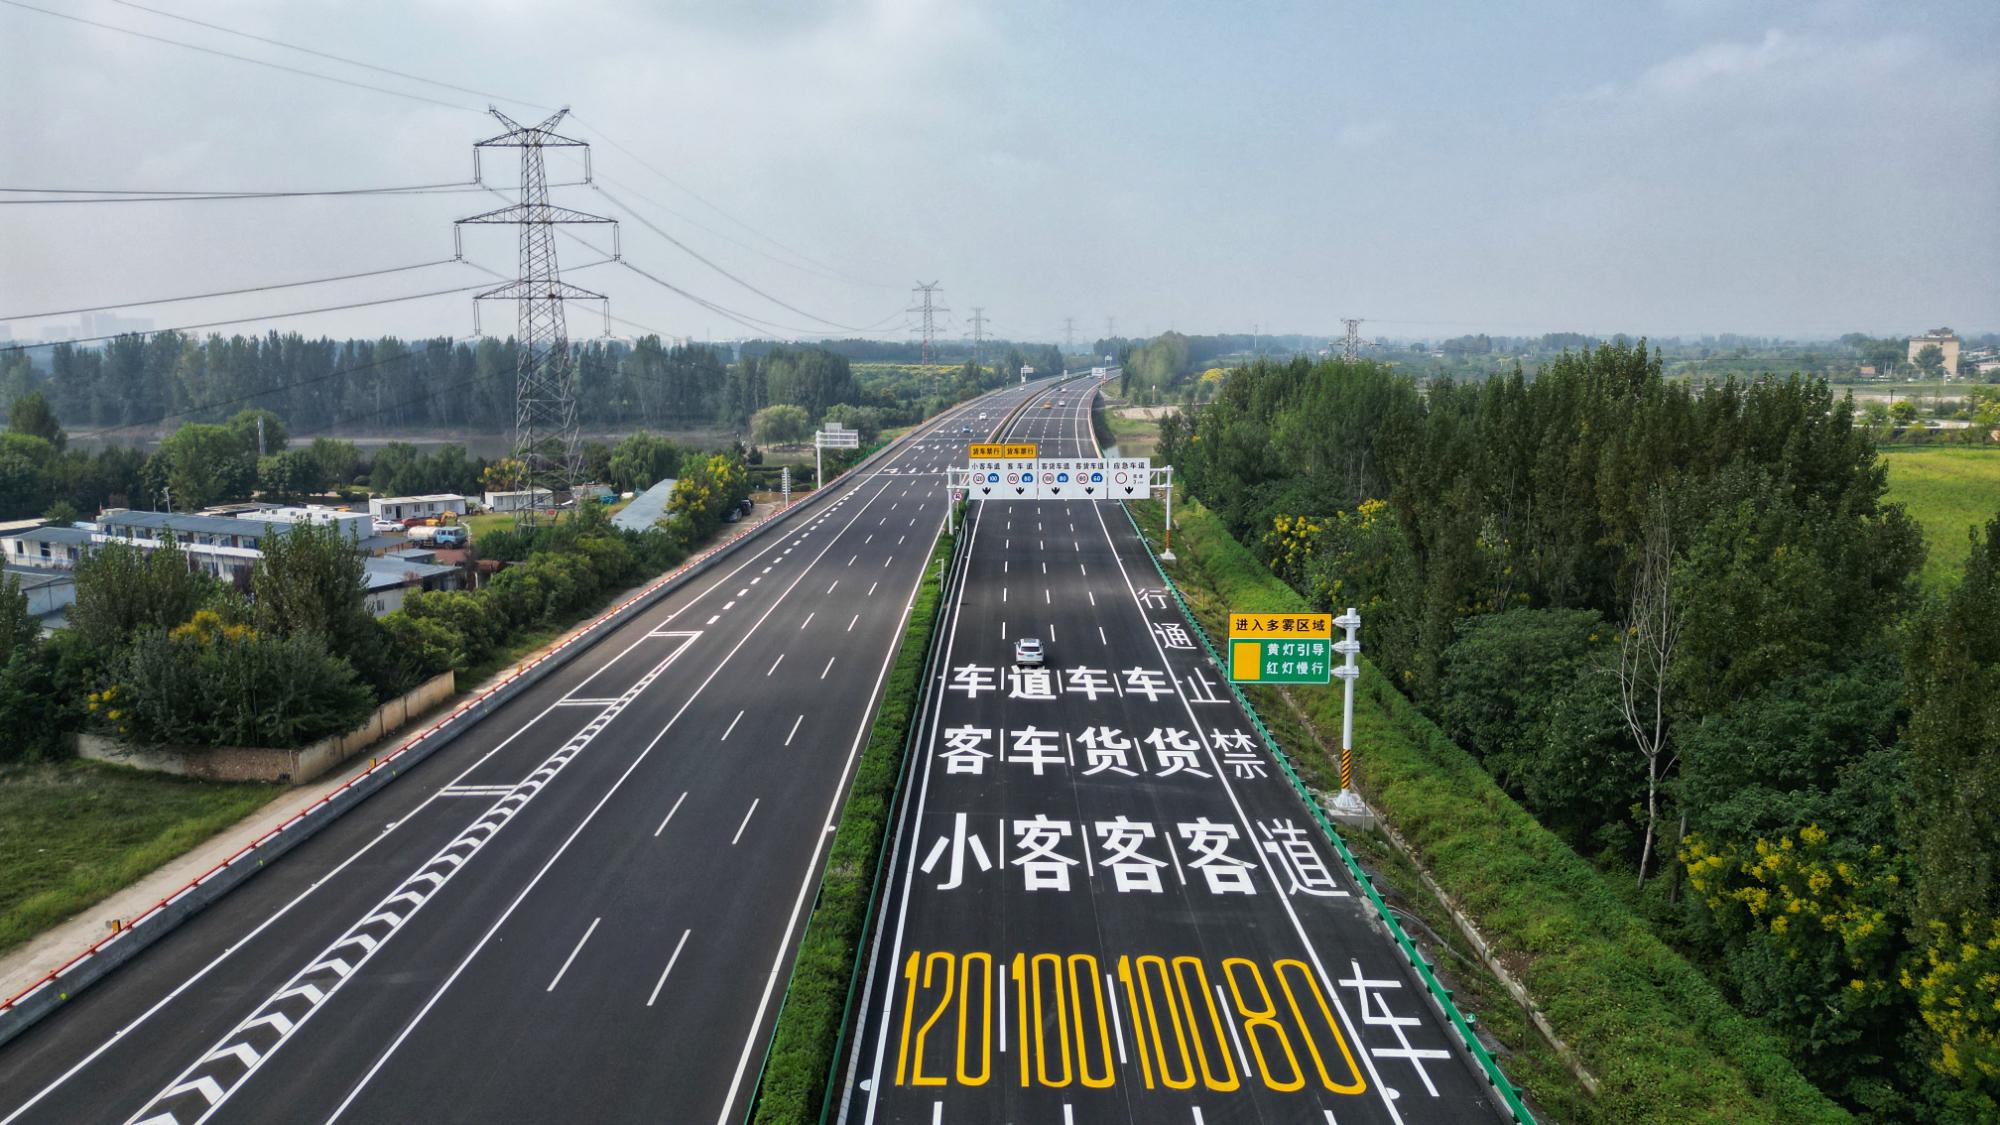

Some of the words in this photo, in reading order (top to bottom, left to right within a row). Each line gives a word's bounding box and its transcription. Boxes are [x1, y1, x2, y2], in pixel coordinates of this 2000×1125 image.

[972, 462, 1000, 470] 小客车道
[1113, 461, 1145, 469] 应急车道
[1236, 618, 1325, 631] 进入多雾区域
[1267, 643, 1325, 656] 黄灯引导
[1266, 661, 1324, 675] 红灯慢行
[895, 950, 993, 1087] 120
[1012, 952, 1115, 1088] 100
[1117, 954, 1240, 1092] 100
[1221, 957, 1366, 1095] 80
